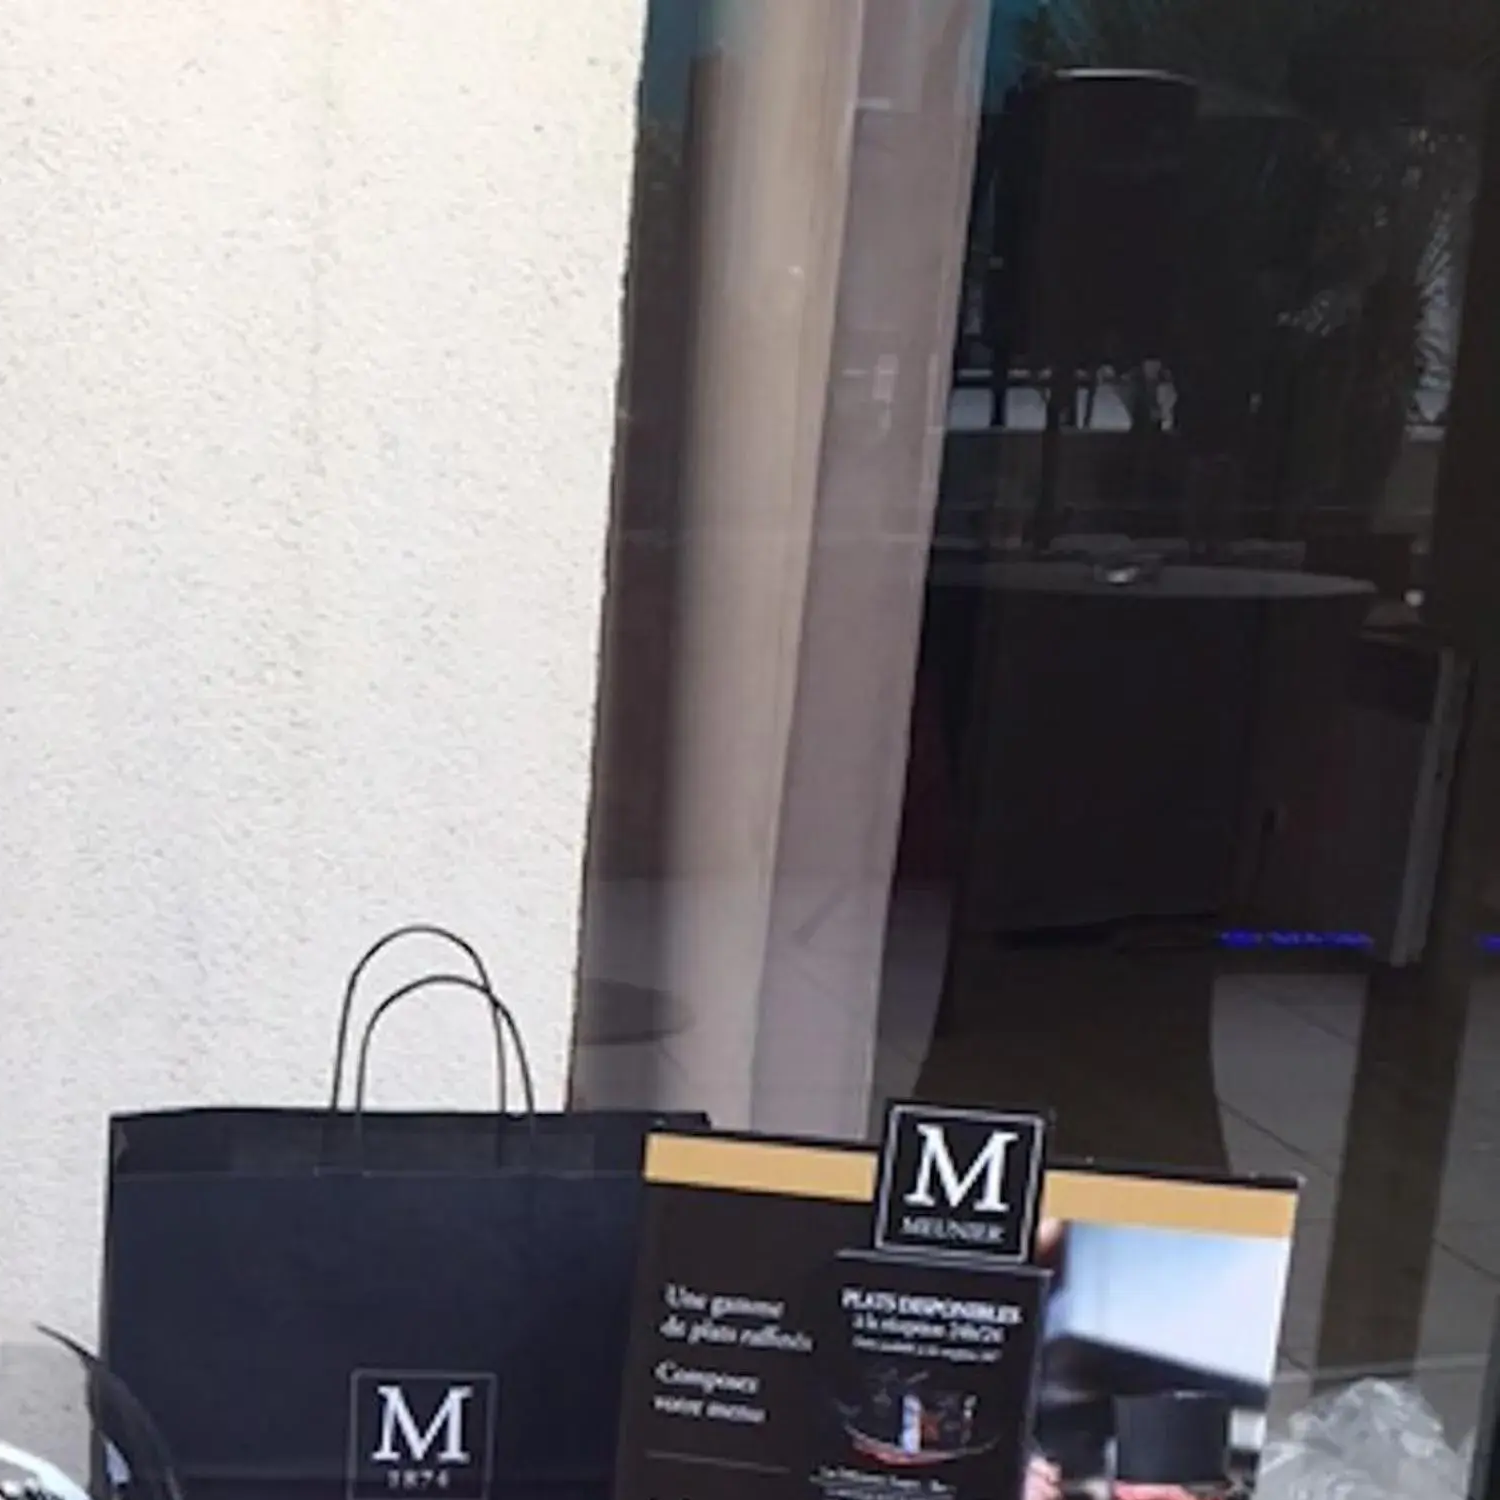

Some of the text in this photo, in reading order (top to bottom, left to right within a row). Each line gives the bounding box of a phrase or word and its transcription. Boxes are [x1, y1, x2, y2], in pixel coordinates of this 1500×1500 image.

[903, 1123, 1019, 1213] M
[902, 1216, 1005, 1241] MEUNIER
[665, 1283, 787, 1319] Une gamme
[841, 1288, 1025, 1325] PLATS DISPONIBLES
[372, 1384, 475, 1465] M
[706, 1402, 766, 1423] menu
